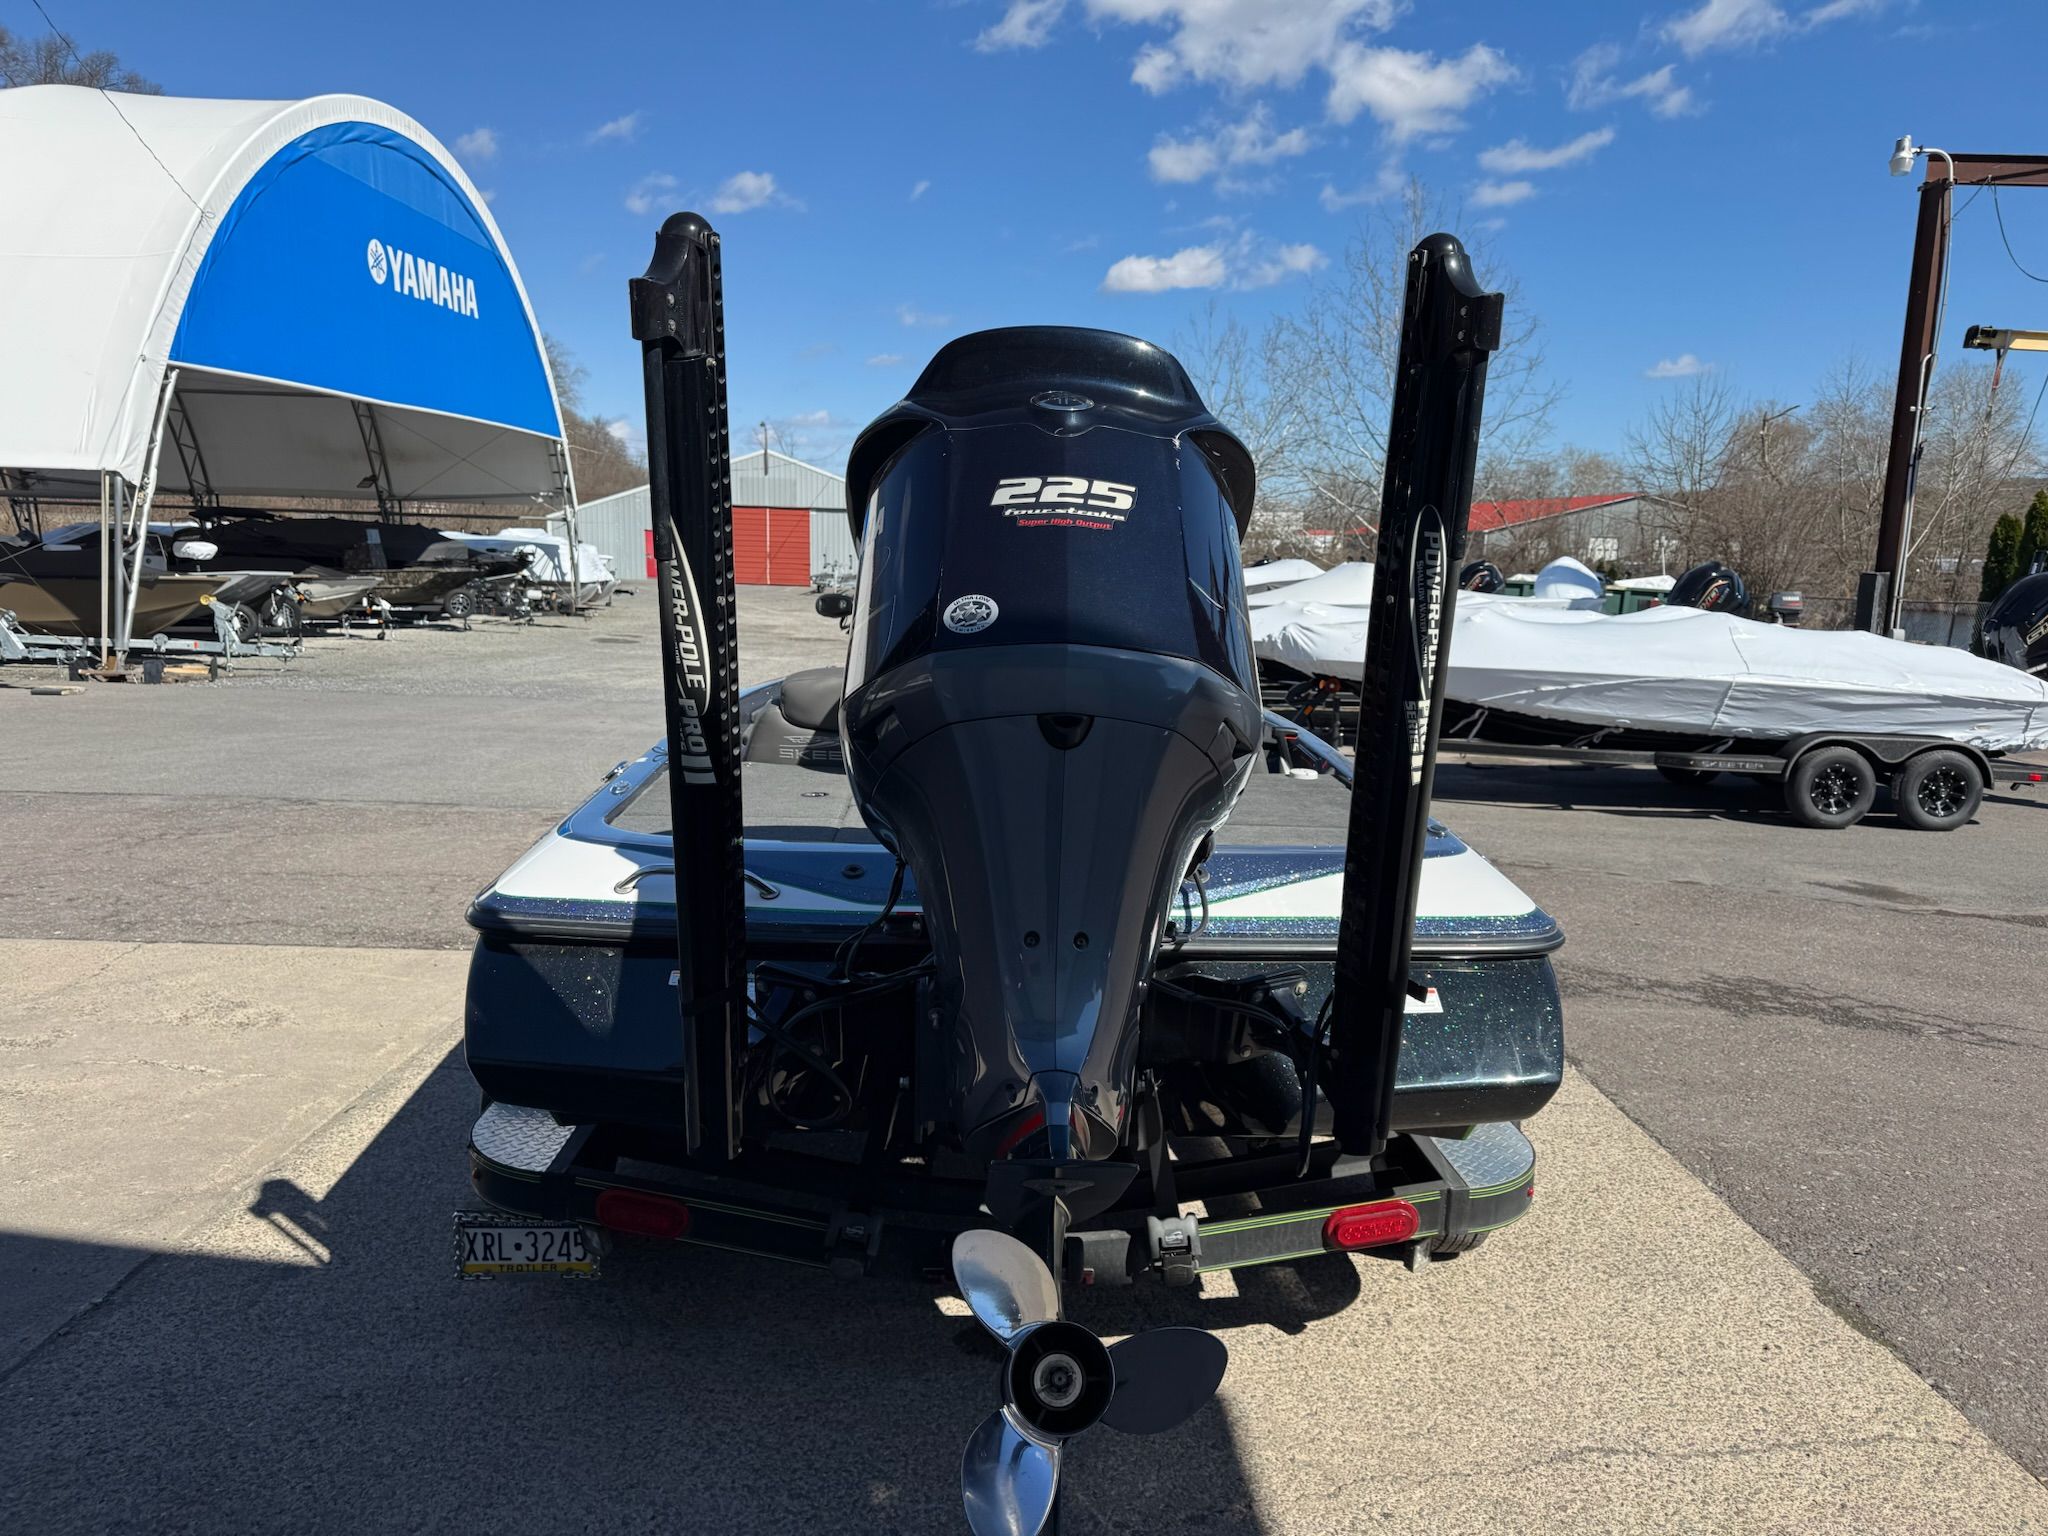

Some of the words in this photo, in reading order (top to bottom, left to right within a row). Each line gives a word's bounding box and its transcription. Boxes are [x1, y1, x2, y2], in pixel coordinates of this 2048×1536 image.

[386, 244, 479, 319] YAMAHA
[990, 476, 1137, 510] 225
[1018, 519, 1048, 527] Super
[1050, 518, 1073, 526] High
[1075, 518, 1112, 530] Output
[679, 698, 708, 753] PRO
[779, 748, 842, 760] SKEE
[1701, 760, 1765, 770] SKEETER
[465, 1231, 512, 1262] XRL
[525, 1231, 588, 1262] 3245
[498, 1264, 558, 1273] TRAILER
